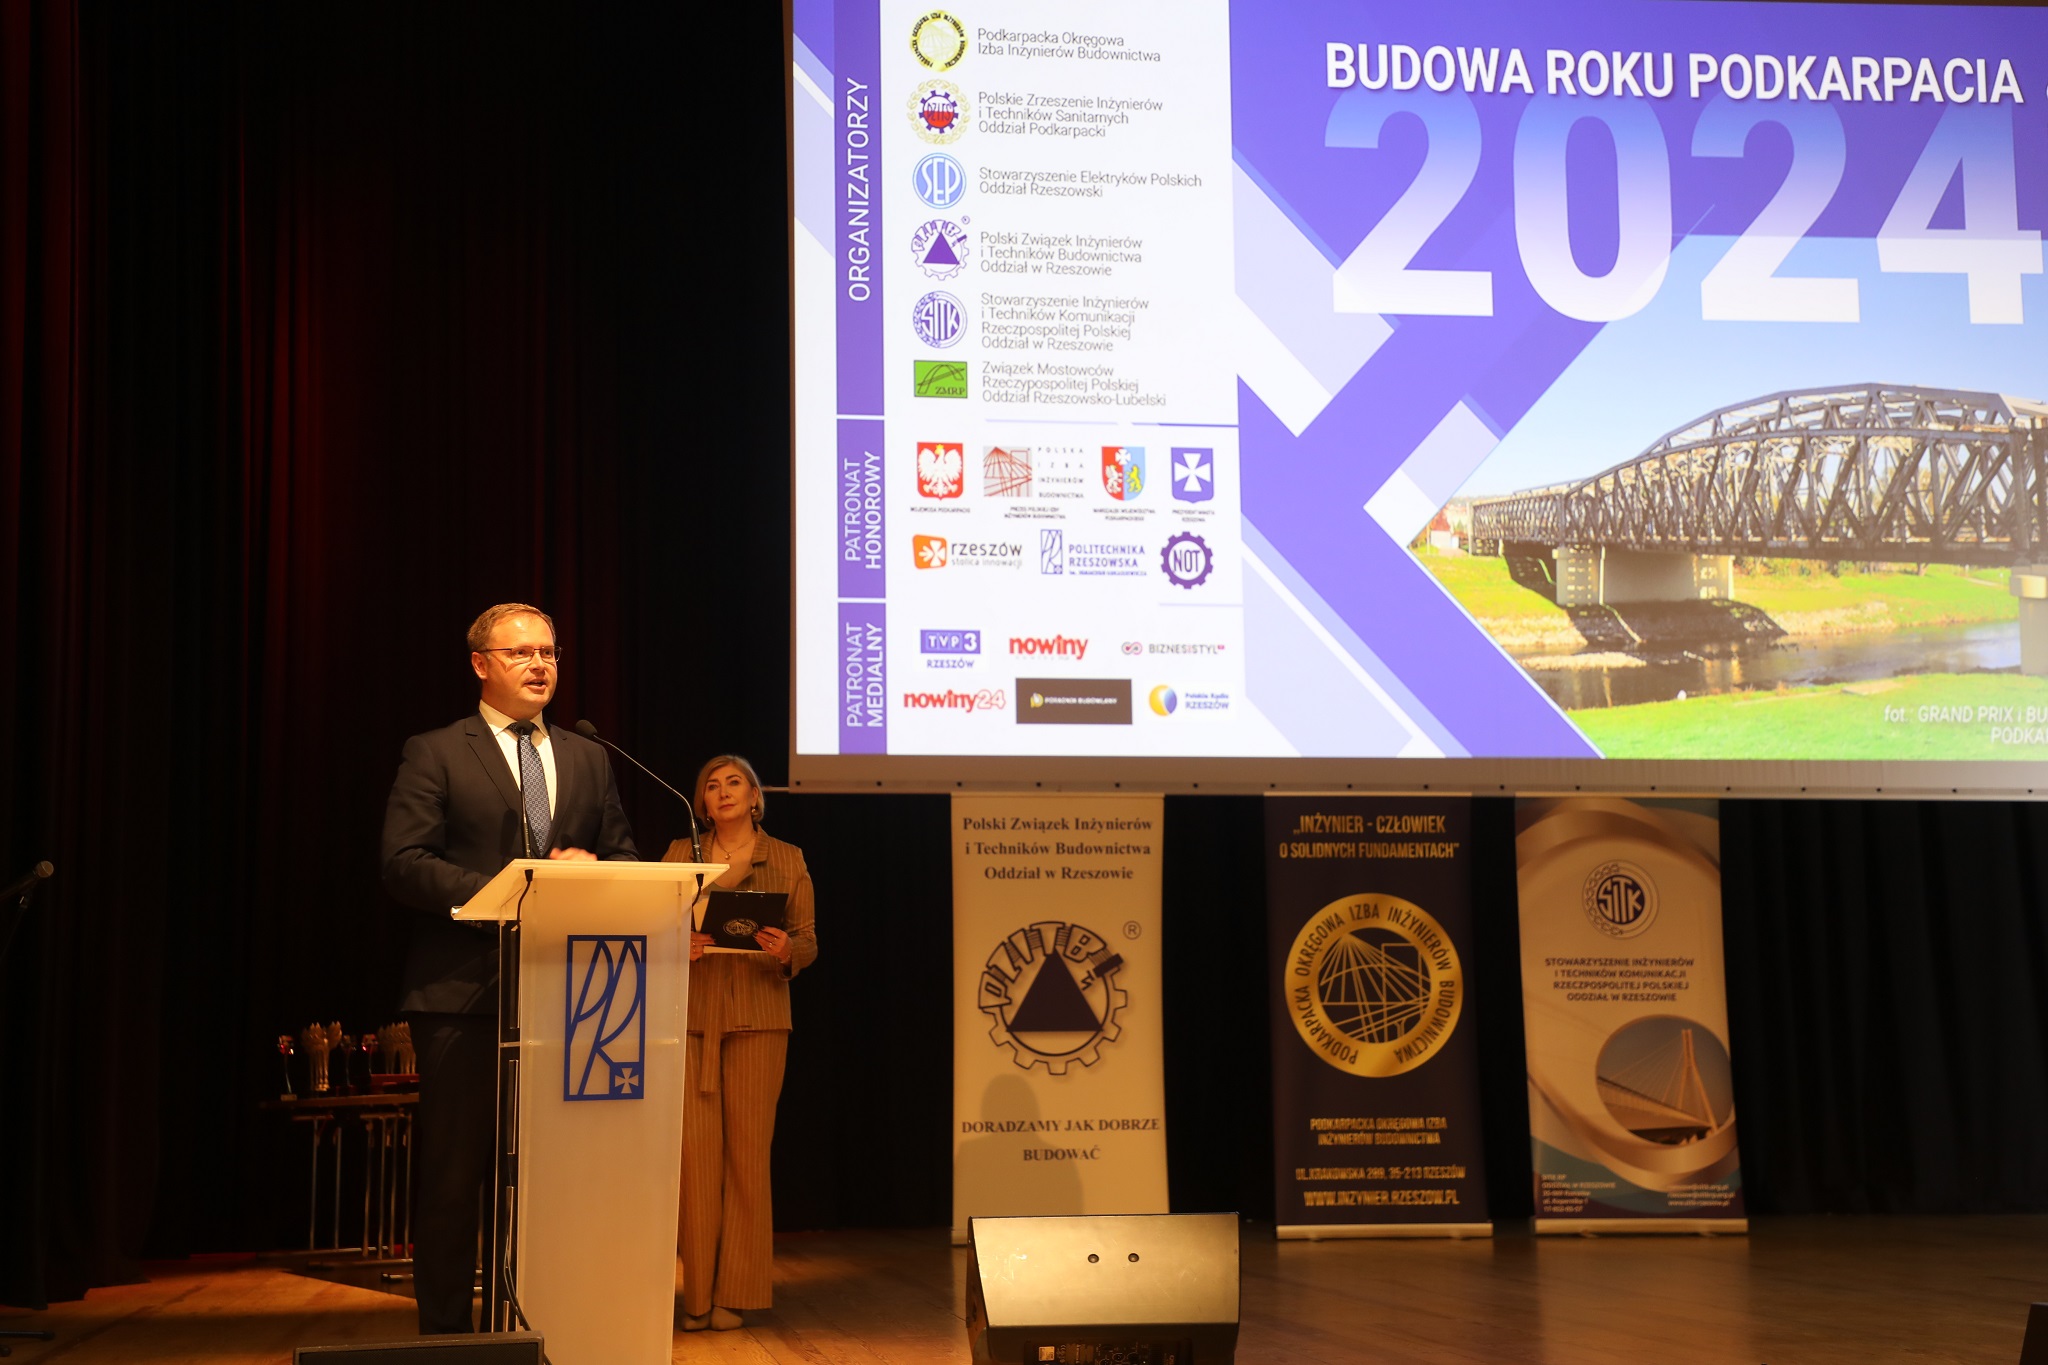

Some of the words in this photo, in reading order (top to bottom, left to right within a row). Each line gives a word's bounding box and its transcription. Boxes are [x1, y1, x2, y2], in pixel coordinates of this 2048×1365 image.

[977, 28, 1058, 45] Podkarpacka
[1062, 32, 1124, 48] Okręgowa
[978, 42, 1004, 55] Izba
[1078, 47, 1161, 62] Budownictwa
[1325, 42, 1534, 95] BUDOWA
[1546, 49, 1673, 98] ROKU
[1689, 53, 2024, 104] PODKARPACIA
[978, 91, 1023, 106] Polskie
[1027, 94, 1094, 109] Zrzeszenie
[1097, 96, 1163, 112] Inżynierów
[986, 106, 1052, 121] Techników
[1056, 110, 1129, 126] Sanitarnych
[978, 121, 1026, 134] Oddział
[1029, 123, 1106, 139] Podkarpacki
[921, 157, 961, 204] SEP
[979, 167, 1077, 184] Stowarzyszenie
[1080, 170, 1147, 187] Elektryków
[1150, 173, 1202, 187] Polskich
[847, 78, 871, 302] ORGANIZATORZY
[979, 181, 1026, 195] Oddział
[1030, 183, 1103, 197] Rzeszowski
[1324, 84, 2044, 324] 2024
[980, 231, 1018, 245] Polski
[1021, 233, 1072, 248] Związek
[1076, 235, 1143, 250] Inżynierów
[988, 246, 1054, 260] Techników
[1058, 248, 1142, 263] Budownictwa
[980, 260, 1027, 273] Oddział
[1031, 263, 1042, 273] w
[1046, 262, 1112, 276] Rzeszowie
[981, 293, 1079, 309] Stowarzyszenie
[1083, 296, 1149, 312] Inżynierów
[988, 307, 1055, 321] Techników
[1059, 309, 1135, 326] Komunikacji
[1083, 325, 1131, 340] Polskiej
[981, 336, 1029, 349] Oddział
[1033, 340, 1044, 349] w
[1047, 338, 1114, 351] Rzeszowie
[982, 361, 1034, 376] Związek
[1037, 363, 1114, 376] Mostowców
[982, 376, 1087, 392] Rzeczypospolitej
[1091, 378, 1139, 393] Polskiej
[982, 389, 1030, 403] Oddział
[1033, 392, 1166, 406] Rzeszowsko-Lubelski
[844, 458, 861, 561] PATRONAT
[865, 451, 882, 570] HONOROWY
[951, 542, 1022, 557] rzeszów
[1069, 544, 1145, 554] POLITECHNIKA
[1069, 557, 1138, 567] RZESZOWSKA
[1173, 549, 1200, 573] NOT
[1009, 634, 1088, 660] nowiny
[926, 658, 975, 668] RZESZÓW
[846, 623, 863, 727] PATRONAT
[867, 623, 884, 727] MEDIALNY
[903, 689, 1006, 713] nowiny24
[1918, 705, 1973, 723] GRAND
[1977, 705, 2014, 722] PRIX
[1990, 726, 2048, 744] PODKA
[963, 817, 1006, 831] Polski
[1010, 817, 1070, 833] Związek
[1074, 817, 1153, 834] Inżynierów
[1376, 815, 1446, 834] CZŁOWIEK
[965, 842, 971, 855] i
[973, 842, 1050, 855] Techników
[1055, 842, 1151, 855] Budownictwa
[1279, 842, 1288, 859] O
[1290, 842, 1356, 859] SOLIDNYCH
[984, 866, 1041, 880] Oddział
[1045, 870, 1056, 879] w
[1061, 866, 1134, 880] Rzeszowie
[1598, 876, 1642, 923] SITK
[1349, 903, 1380, 921] IZBA
[1294, 912, 1345, 977] OKRĘGOWA
[1387, 905, 1452, 972] INŻYNIERÓW
[1545, 957, 1630, 966] STOWARZYSZENIE
[1632, 956, 1694, 966] INŻYNIERÓW
[1560, 968, 1616, 978] TECHNIKÓW
[1618, 969, 1686, 978] KOMUNIKACJI
[1553, 981, 1640, 990] RZECZPOSPOLITEJ
[1643, 981, 1690, 990] POLSKIEJ
[1566, 993, 1609, 1001] ODDZIAŁ
[1621, 993, 1677, 1001] RZESZOWIE
[1294, 985, 1359, 1065] PODKARPACKA
[1394, 980, 1455, 1065] BUDOWNICTWA
[962, 1120, 1060, 1134] DORADZAMY
[1064, 1119, 1095, 1133] JAK
[1098, 1118, 1160, 1132] DOBRZE
[1023, 1145, 1101, 1161] BUDOWAĆ
